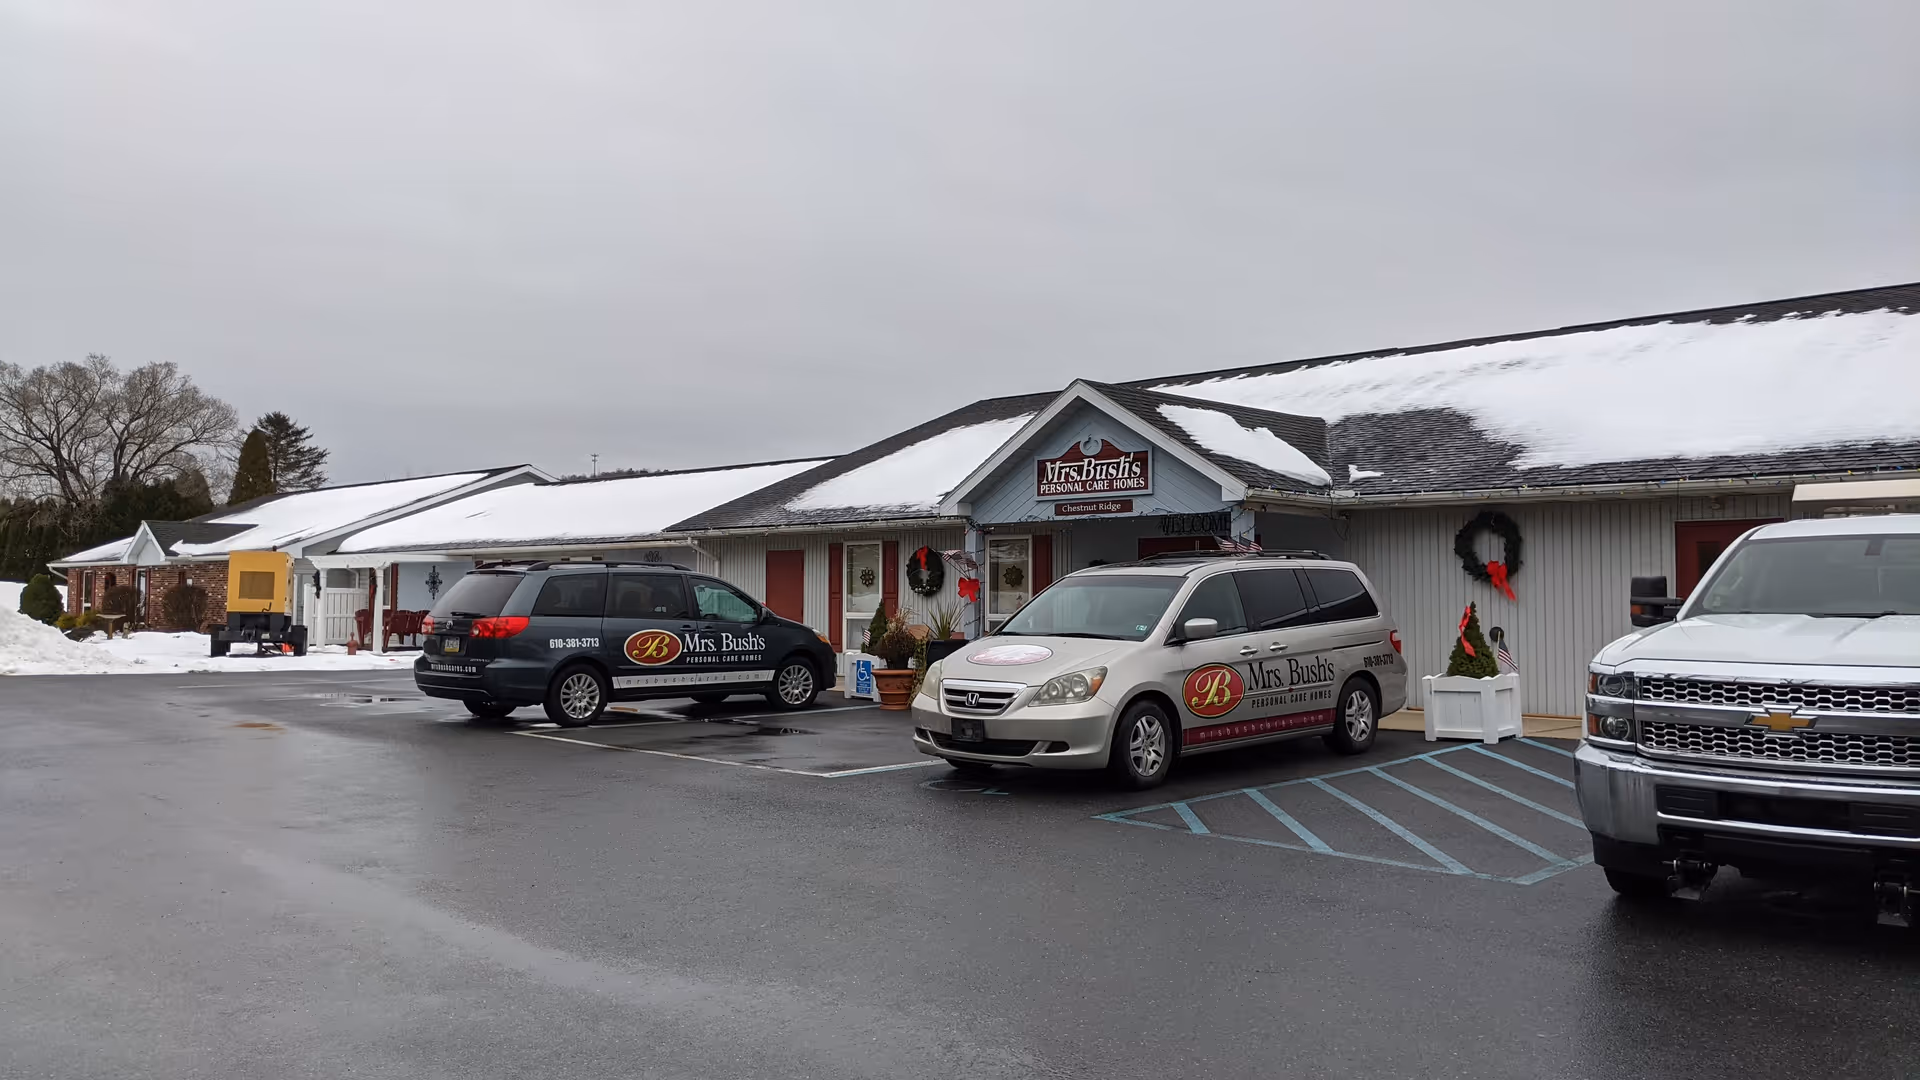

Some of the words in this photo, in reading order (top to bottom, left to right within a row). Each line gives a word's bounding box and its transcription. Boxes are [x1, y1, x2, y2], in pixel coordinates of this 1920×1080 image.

[1040, 481, 1084, 494] PERSONAL
[1086, 480, 1110, 491] CARE
[1113, 477, 1145, 489] HOMES
[1062, 503, 1096, 513] Chestnut
[1098, 502, 1121, 512] Ridge
[549, 637, 600, 649] 610-381-3713
[682, 633, 717, 652] Mrs.
[720, 632, 766, 651] Bush's
[686, 655, 719, 664] PERSONAL
[741, 654, 762, 662] HOMES
[1247, 661, 1284, 691] Mrs.
[1286, 655, 1336, 686] Bush's
[1251, 695, 1287, 709] PERSONAL
[1290, 693, 1307, 703] CARE
[1310, 689, 1332, 701] HOMES
